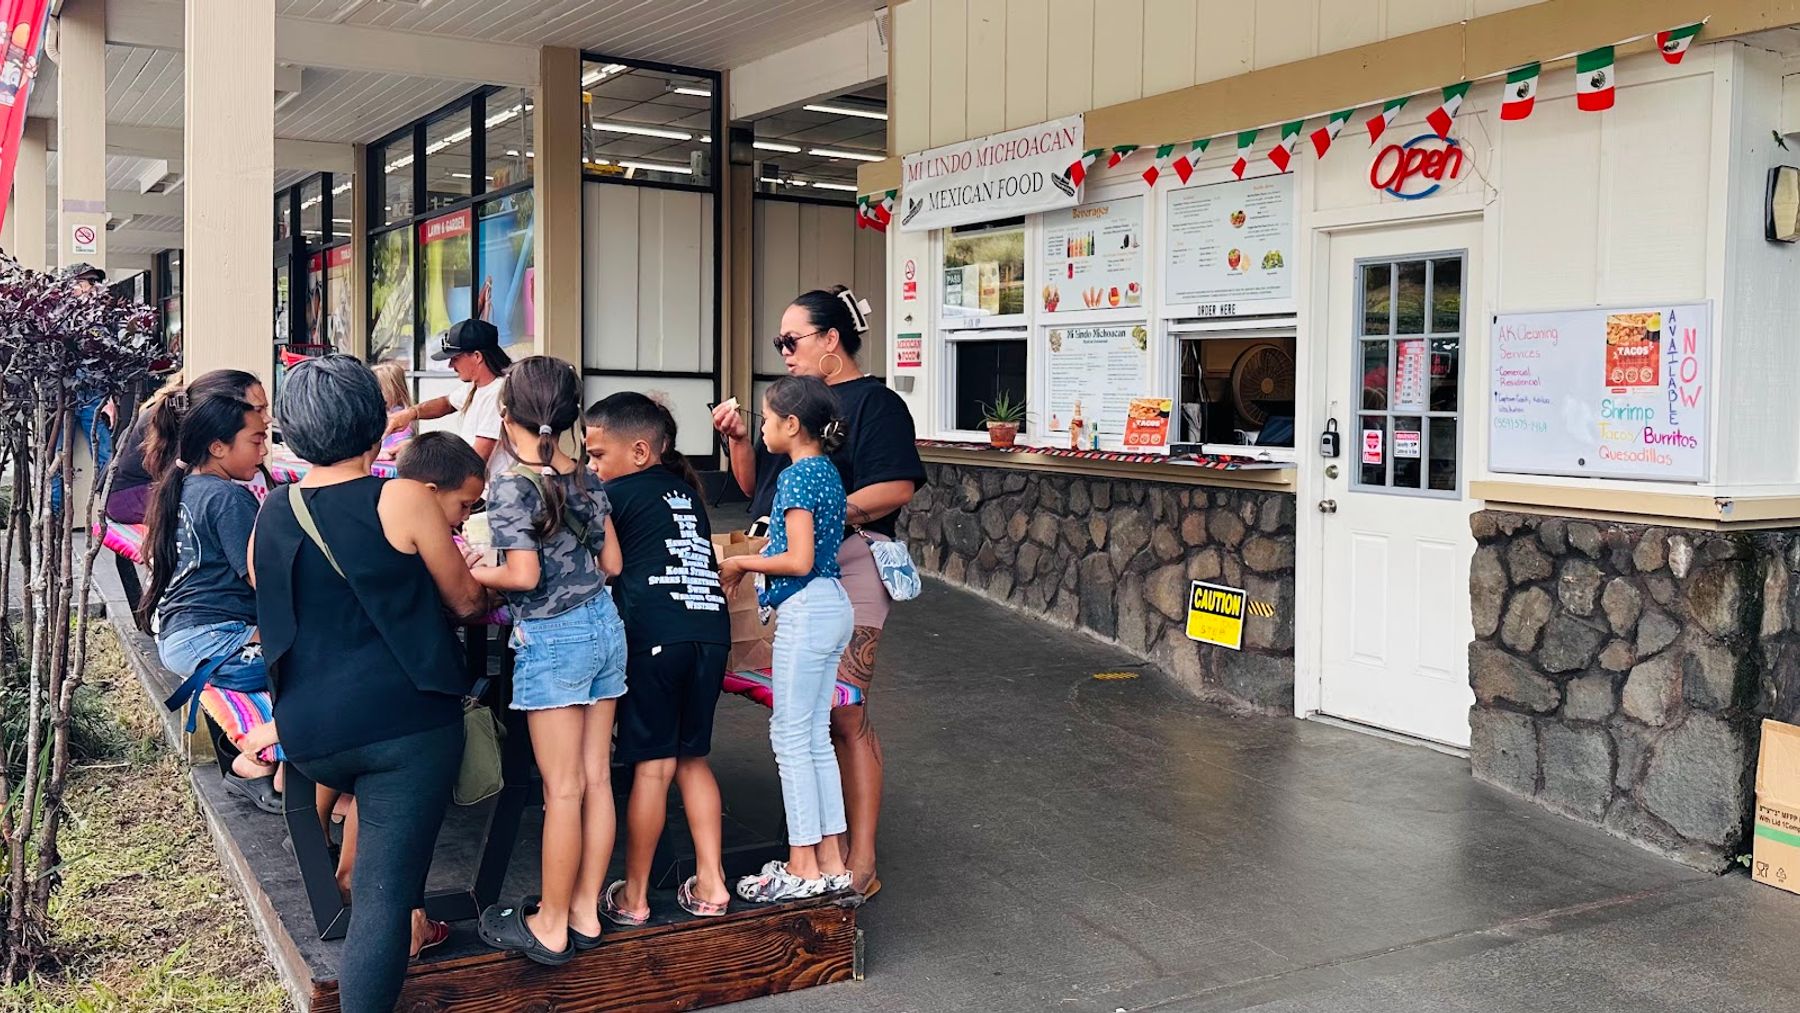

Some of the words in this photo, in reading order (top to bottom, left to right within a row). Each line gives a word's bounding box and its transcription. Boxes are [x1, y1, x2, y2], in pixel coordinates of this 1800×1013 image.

[908, 161, 923, 182] MI
[927, 151, 972, 178] LINDO
[976, 126, 1077, 168] MICHOACAN
[1370, 144, 1463, 192] Open
[929, 181, 994, 211] MEXICAN
[998, 171, 1044, 199] FOOD
[445, 215, 465, 233] GARDEN
[1072, 206, 1109, 219] Beverages
[1197, 305, 1216, 316] ORDER
[1220, 304, 1236, 315] HERE
[1517, 323, 1559, 346] Cleaning
[1499, 344, 1541, 360] Services
[1616, 346, 1649, 356] TACOS
[1679, 327, 1703, 409] NOW
[1601, 398, 1655, 426] Shrimp
[1644, 426, 1698, 449] Burritos
[1599, 445, 1673, 466] Quesadillas
[1194, 587, 1241, 616] CAUTION
